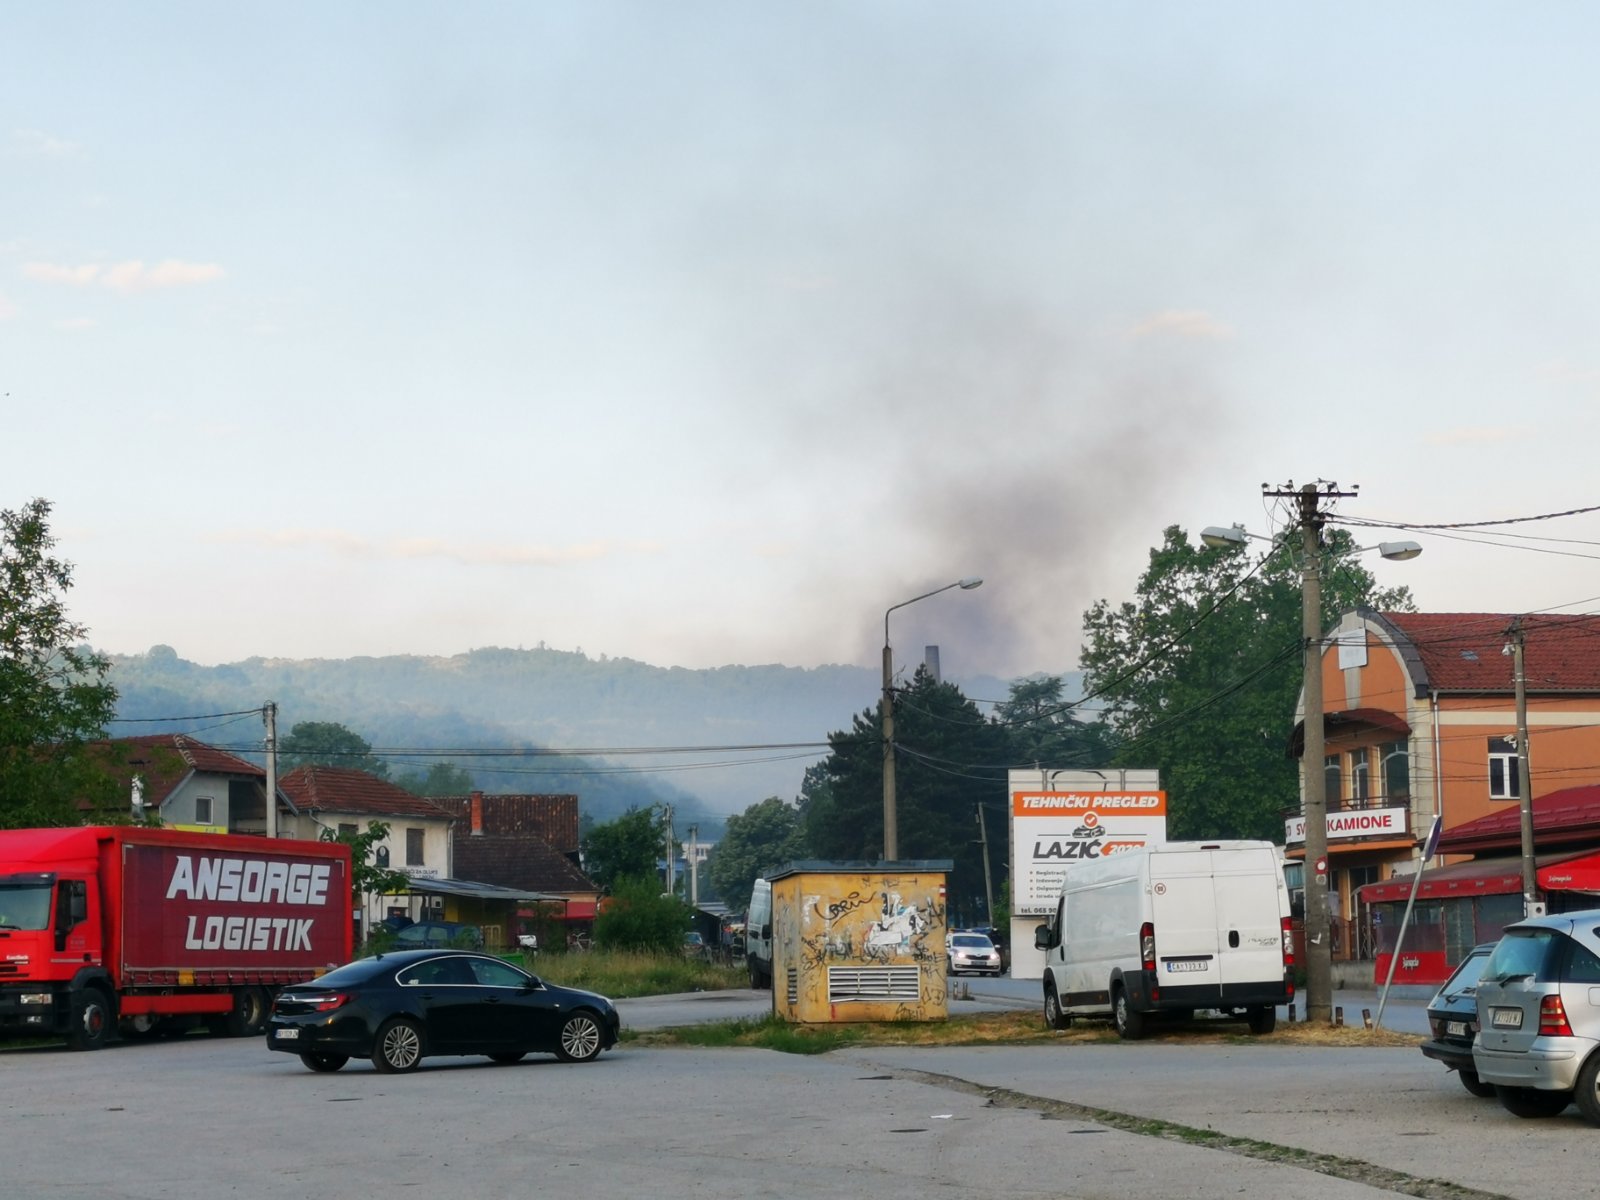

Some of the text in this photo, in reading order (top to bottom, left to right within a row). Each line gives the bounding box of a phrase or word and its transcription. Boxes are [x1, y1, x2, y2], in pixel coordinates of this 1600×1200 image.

[1022, 795, 1159, 808] TEHNIČKI PREGLED
[1296, 823, 1306, 835] SV
[1327, 815, 1392, 832] KAMIONE
[1033, 839, 1101, 859] LAZIĆ
[165, 855, 331, 905] ANSORGE
[185, 915, 315, 951] LOGISTIK
